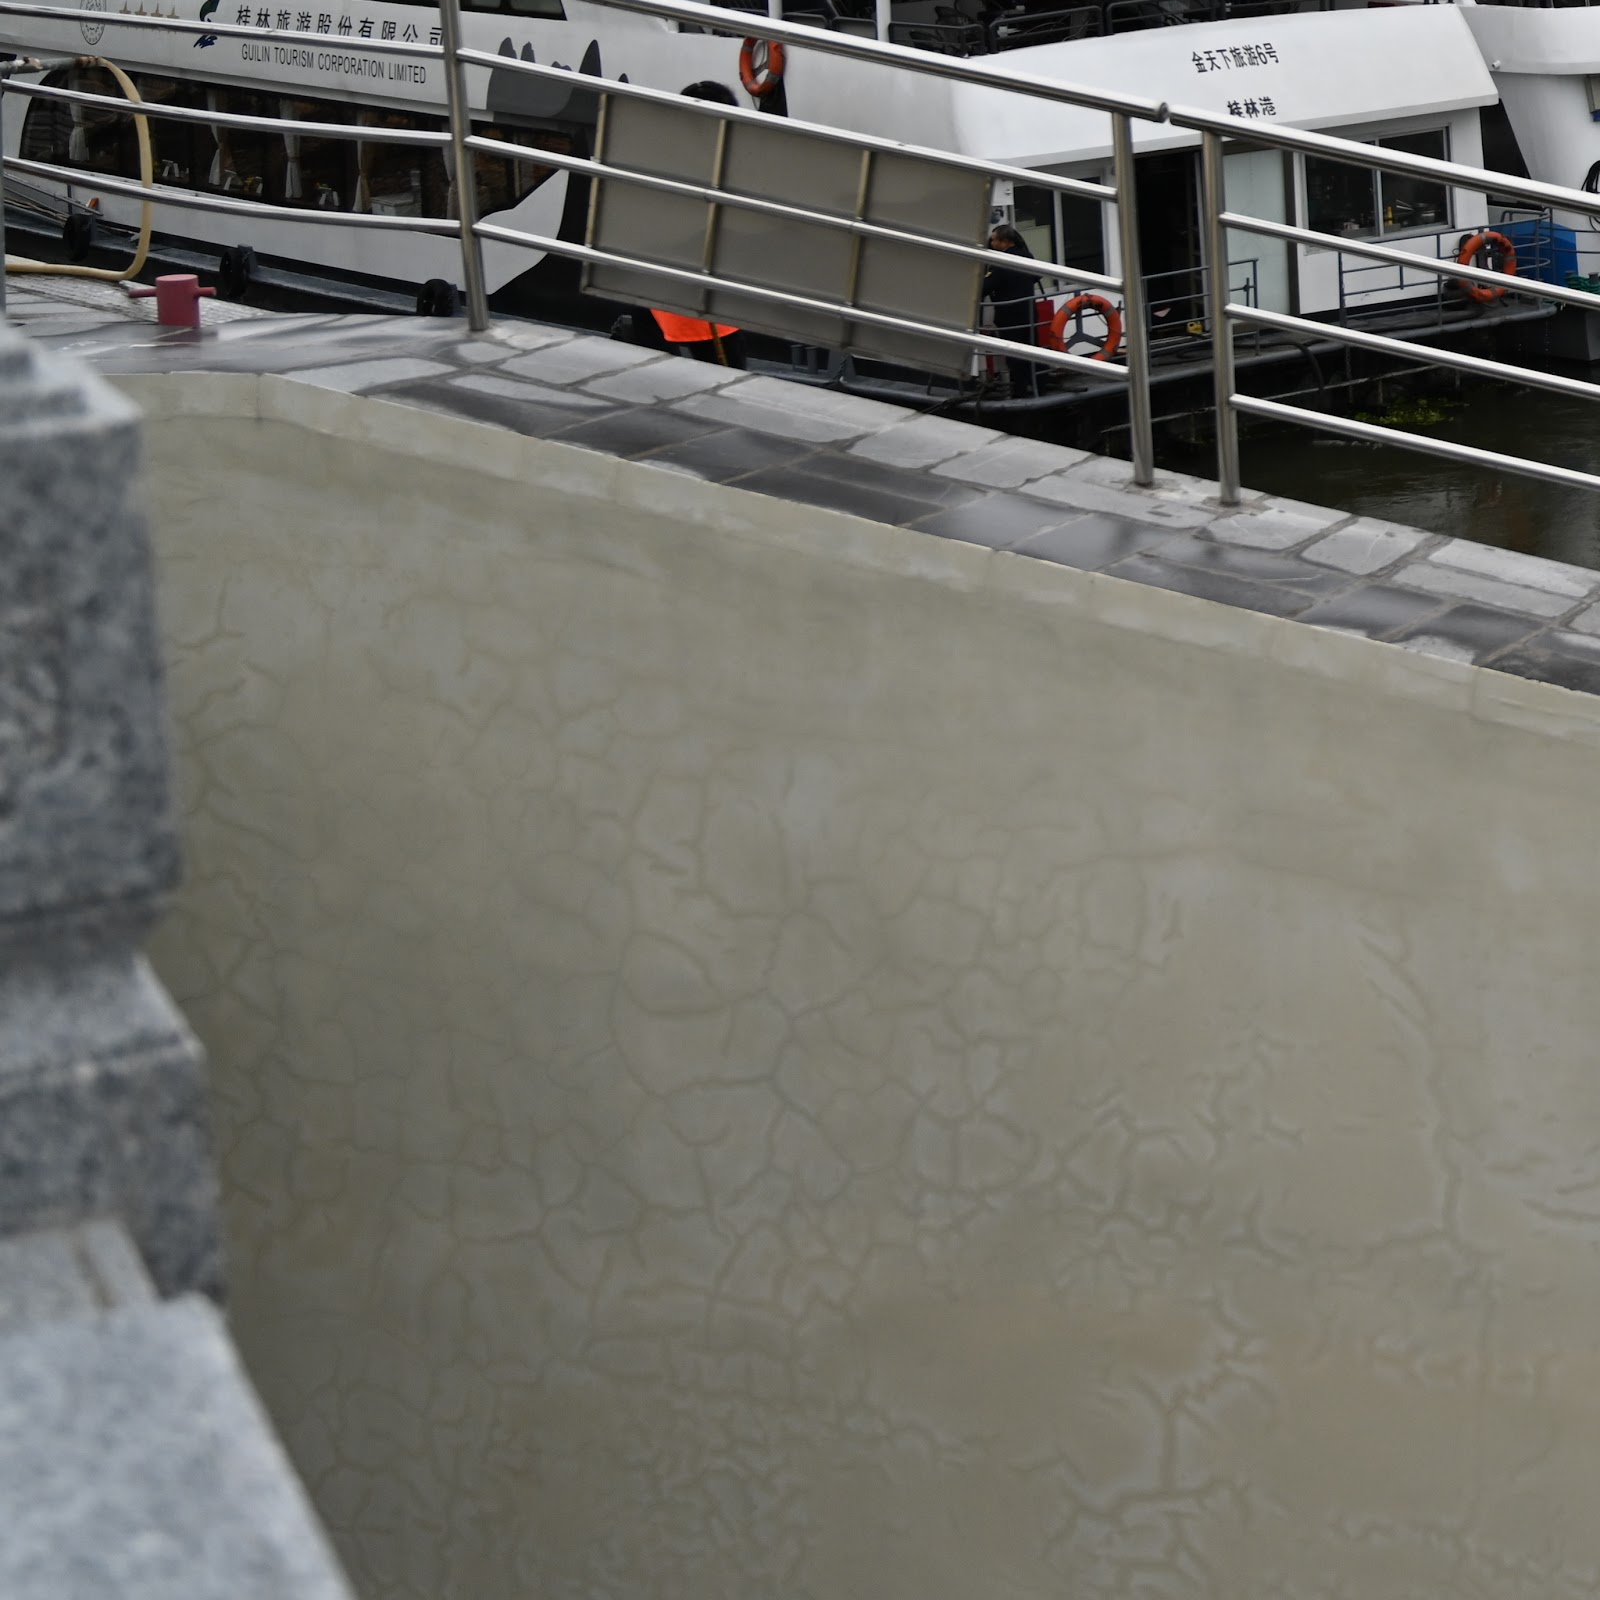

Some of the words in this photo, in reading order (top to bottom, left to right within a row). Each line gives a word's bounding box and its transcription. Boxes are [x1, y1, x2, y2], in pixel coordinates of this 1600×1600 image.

[241, 43, 270, 62] GUILIN
[274, 47, 314, 69] TOURISM
[317, 53, 385, 79] CORPORATION
[388, 62, 427, 84] LIMITED
[1191, 42, 1280, 74] 金天下旅游6号
[1226, 96, 1277, 118] 桂林港
